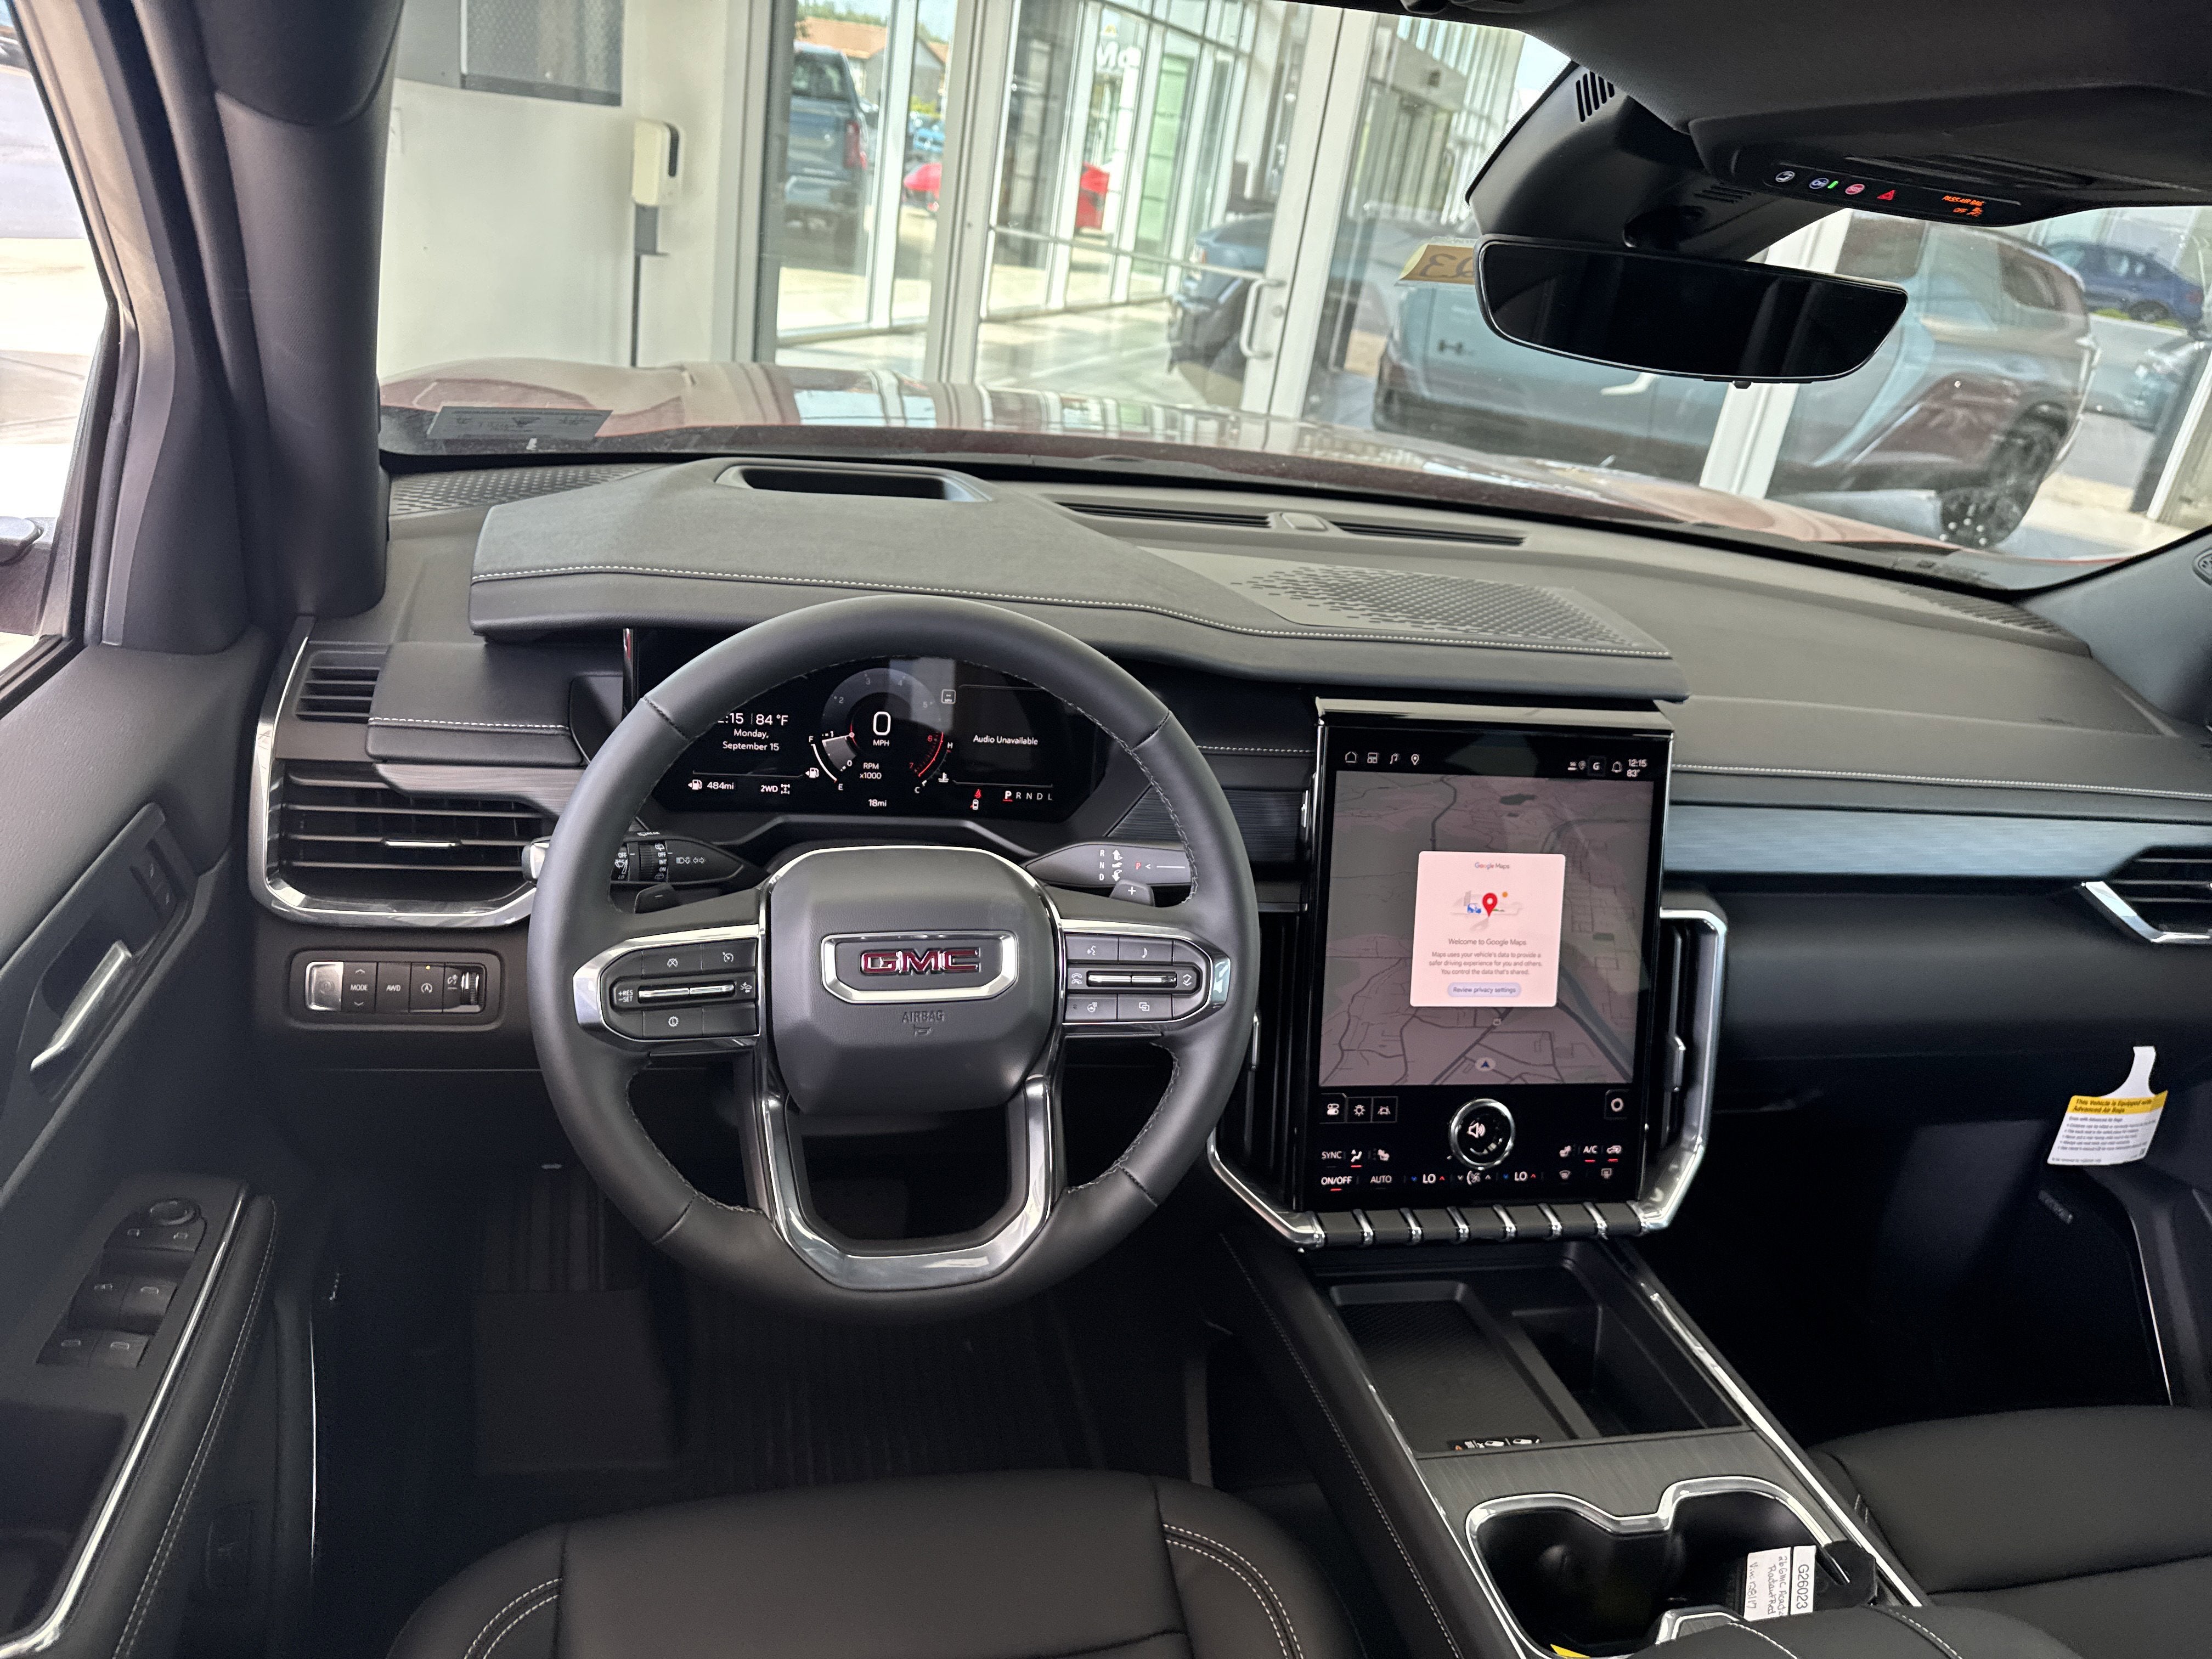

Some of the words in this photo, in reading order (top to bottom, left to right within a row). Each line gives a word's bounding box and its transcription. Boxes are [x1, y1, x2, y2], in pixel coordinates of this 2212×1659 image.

[718, 713, 744, 724] :15
[756, 714, 773, 725] 84
[776, 714, 788, 726] °F
[873, 712, 891, 736] 0
[733, 729, 769, 739] Monday,
[973, 735, 995, 743] Audio
[996, 736, 1039, 745] Unavailable
[723, 741, 768, 751] September
[1005, 791, 1012, 799] P
[1475, 862, 1494, 870] Google
[860, 947, 981, 975] GMC
[350, 984, 368, 992] MODE
[902, 1010, 945, 1023] AIRBAG
[1583, 1145, 1598, 1154] A/C
[1322, 1151, 1342, 1160] SYNC
[1321, 1176, 1352, 1185] ON/OFF
[1370, 1175, 1393, 1184] AUTO
[1423, 1173, 1436, 1184] LO
[1514, 1171, 1528, 1182] LO
[1779, 1567, 1788, 1588] GMC
[1796, 1564, 1809, 1610] G26023
